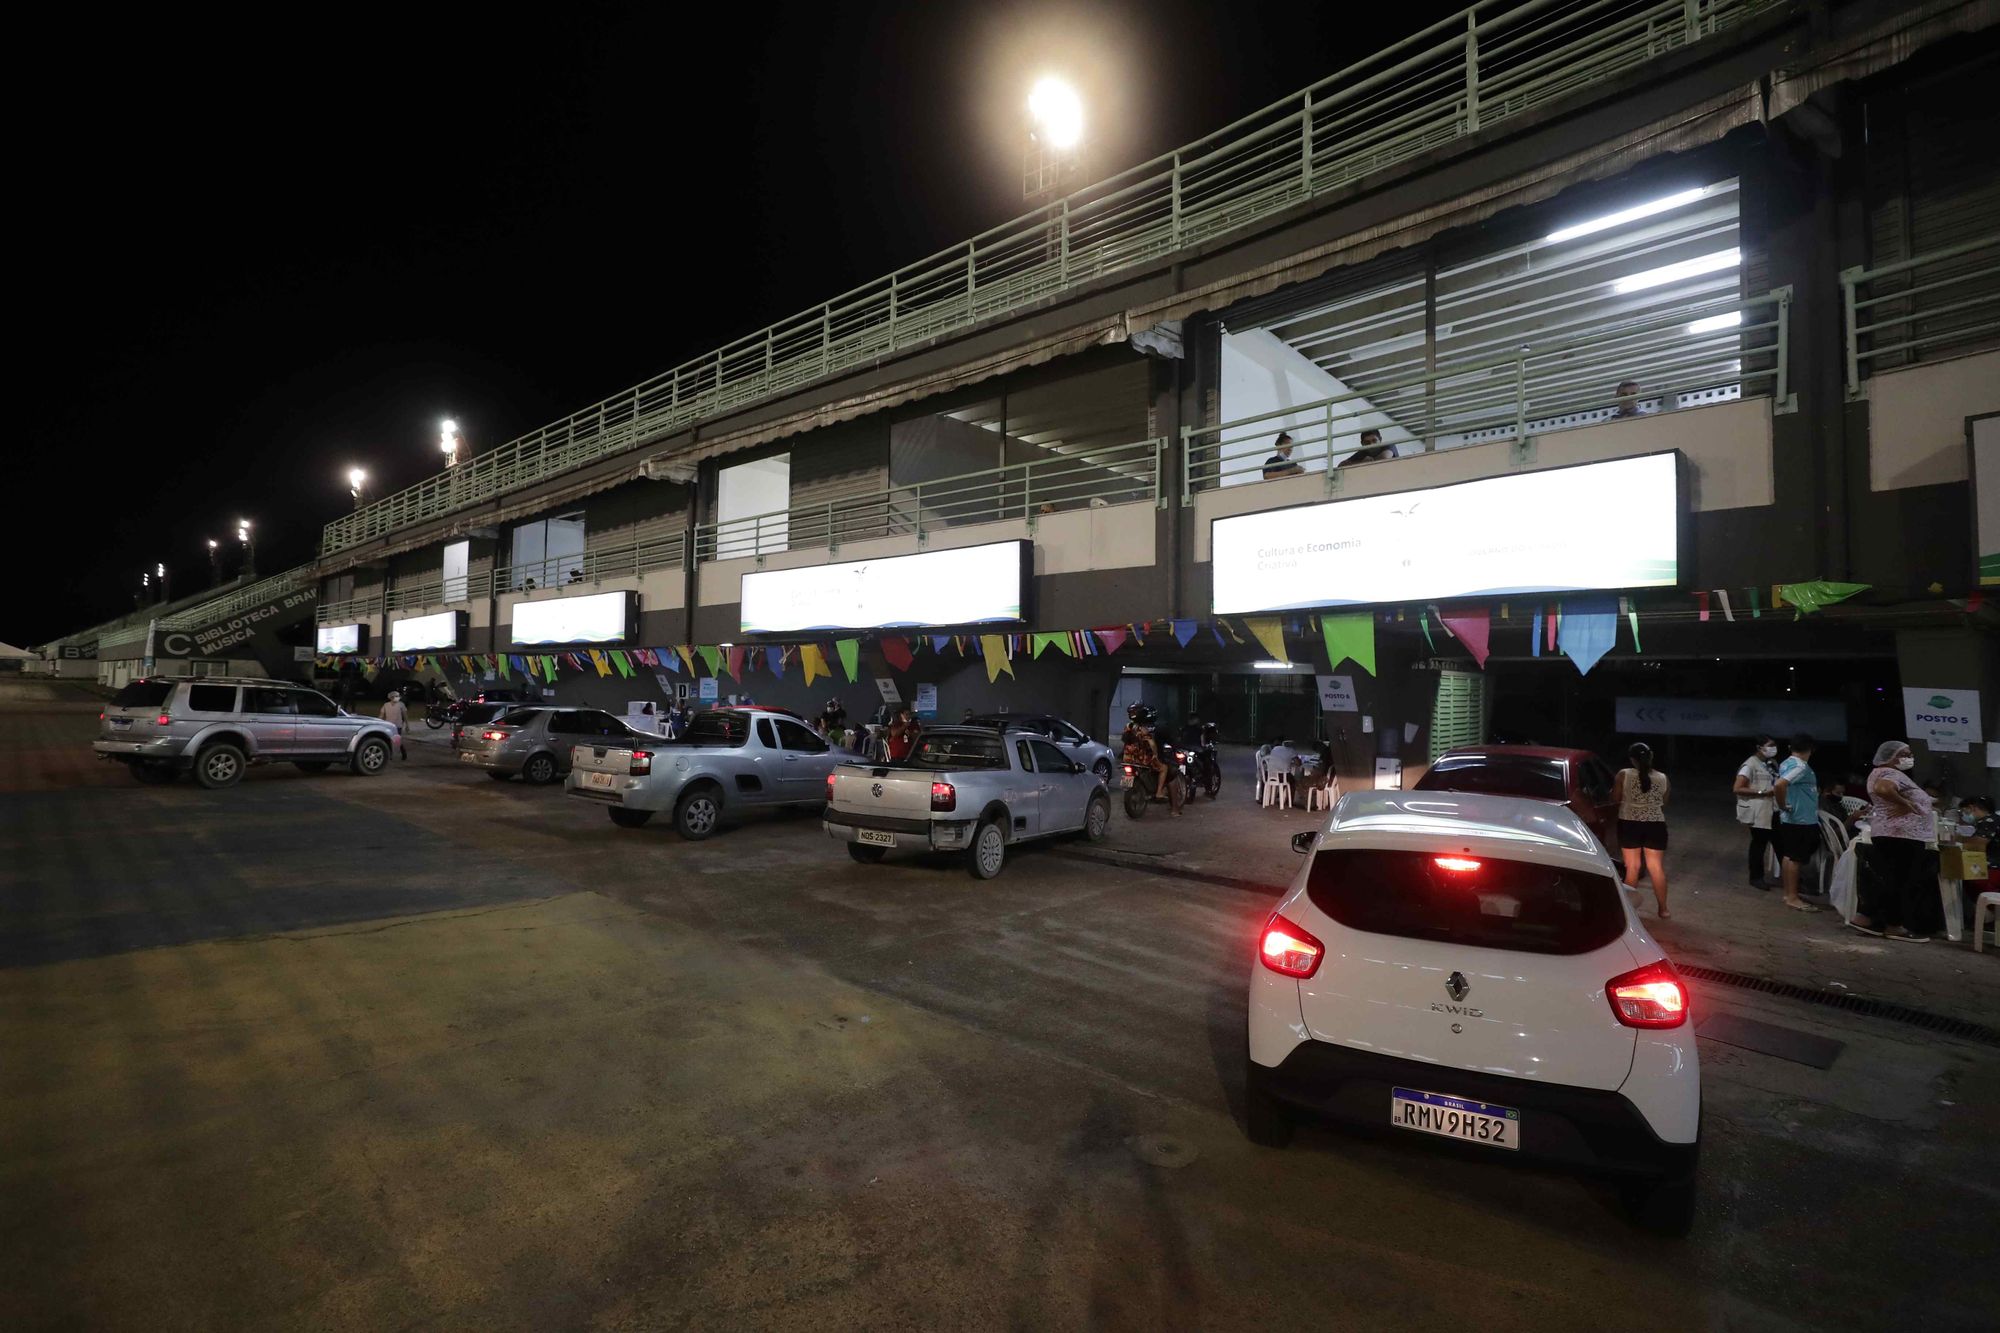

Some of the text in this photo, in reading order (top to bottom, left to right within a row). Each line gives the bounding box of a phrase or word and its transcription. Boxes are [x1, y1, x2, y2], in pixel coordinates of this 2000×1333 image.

[1257, 537, 1362, 558] Cultura e Economia
[194, 605, 279, 645] BIBLIOTECA
[164, 634, 191, 655] C
[200, 627, 257, 656] MUSICA
[64, 647, 80, 658] B
[679, 685, 686, 697] D
[1916, 714, 1958, 723] POSTO
[1444, 1101, 1465, 1109] BRASIL
[1404, 1103, 1505, 1143] RMV9H32
